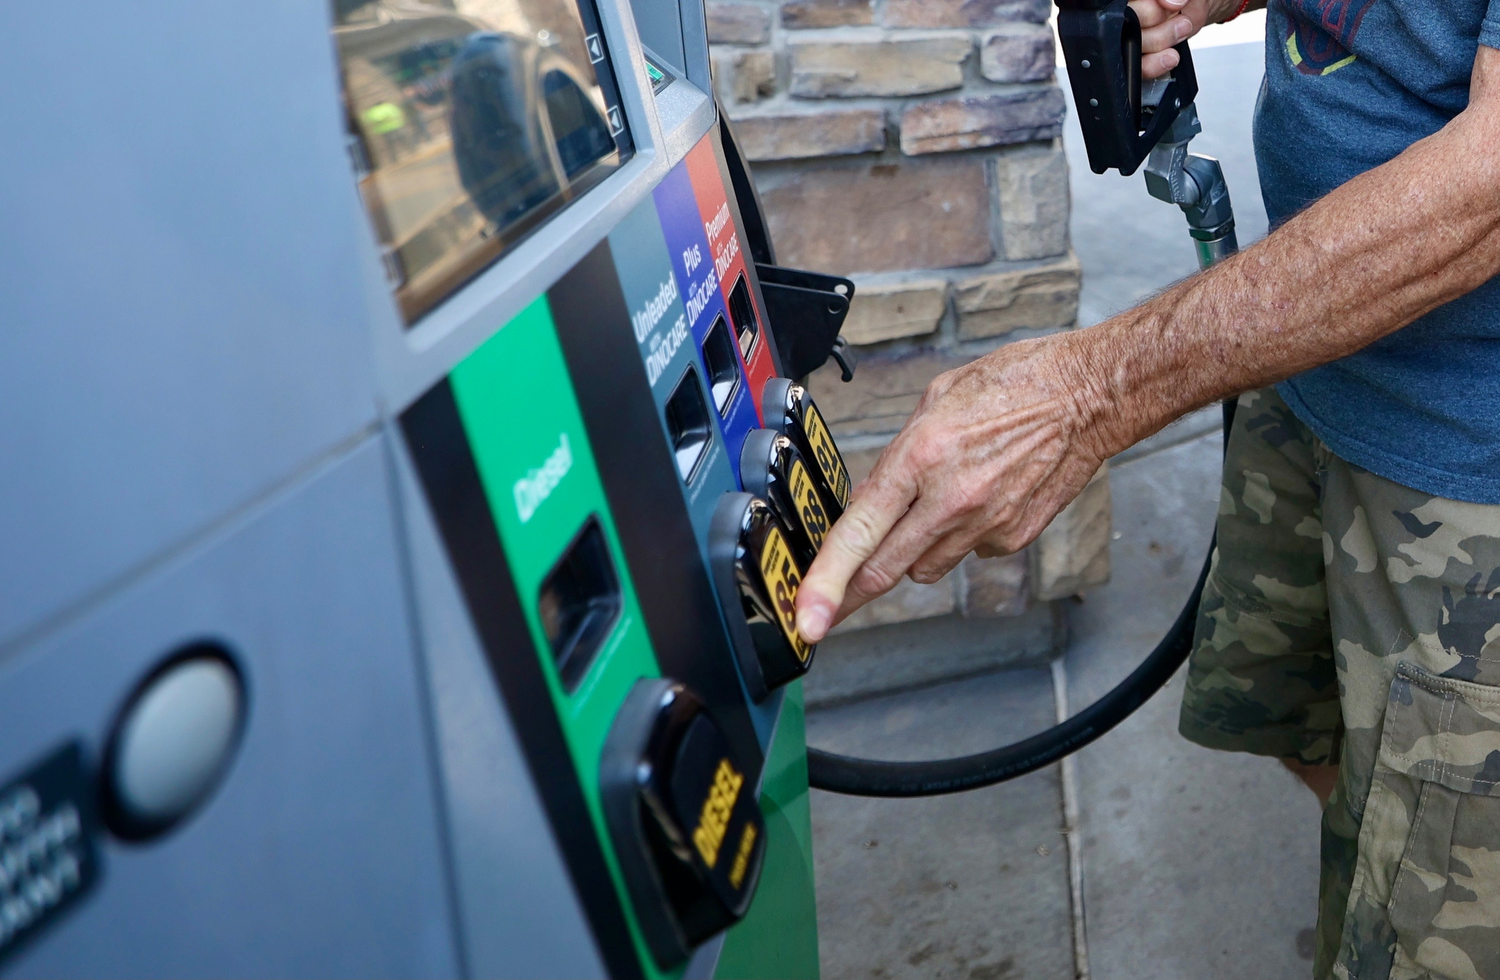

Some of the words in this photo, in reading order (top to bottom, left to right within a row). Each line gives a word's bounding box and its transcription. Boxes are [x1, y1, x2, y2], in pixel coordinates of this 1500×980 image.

[705, 201, 730, 247] Premium
[682, 244, 702, 277] Plus
[715, 232, 739, 283] DINOCARE
[632, 271, 678, 344] Unleaded
[686, 268, 718, 329] DINOCARE
[645, 313, 688, 388] DINOCARE
[513, 431, 573, 524] Diesel
[816, 430, 838, 486] 91
[802, 488, 827, 553] 88
[775, 554, 801, 634] 85
[694, 759, 743, 868] DIESEL
